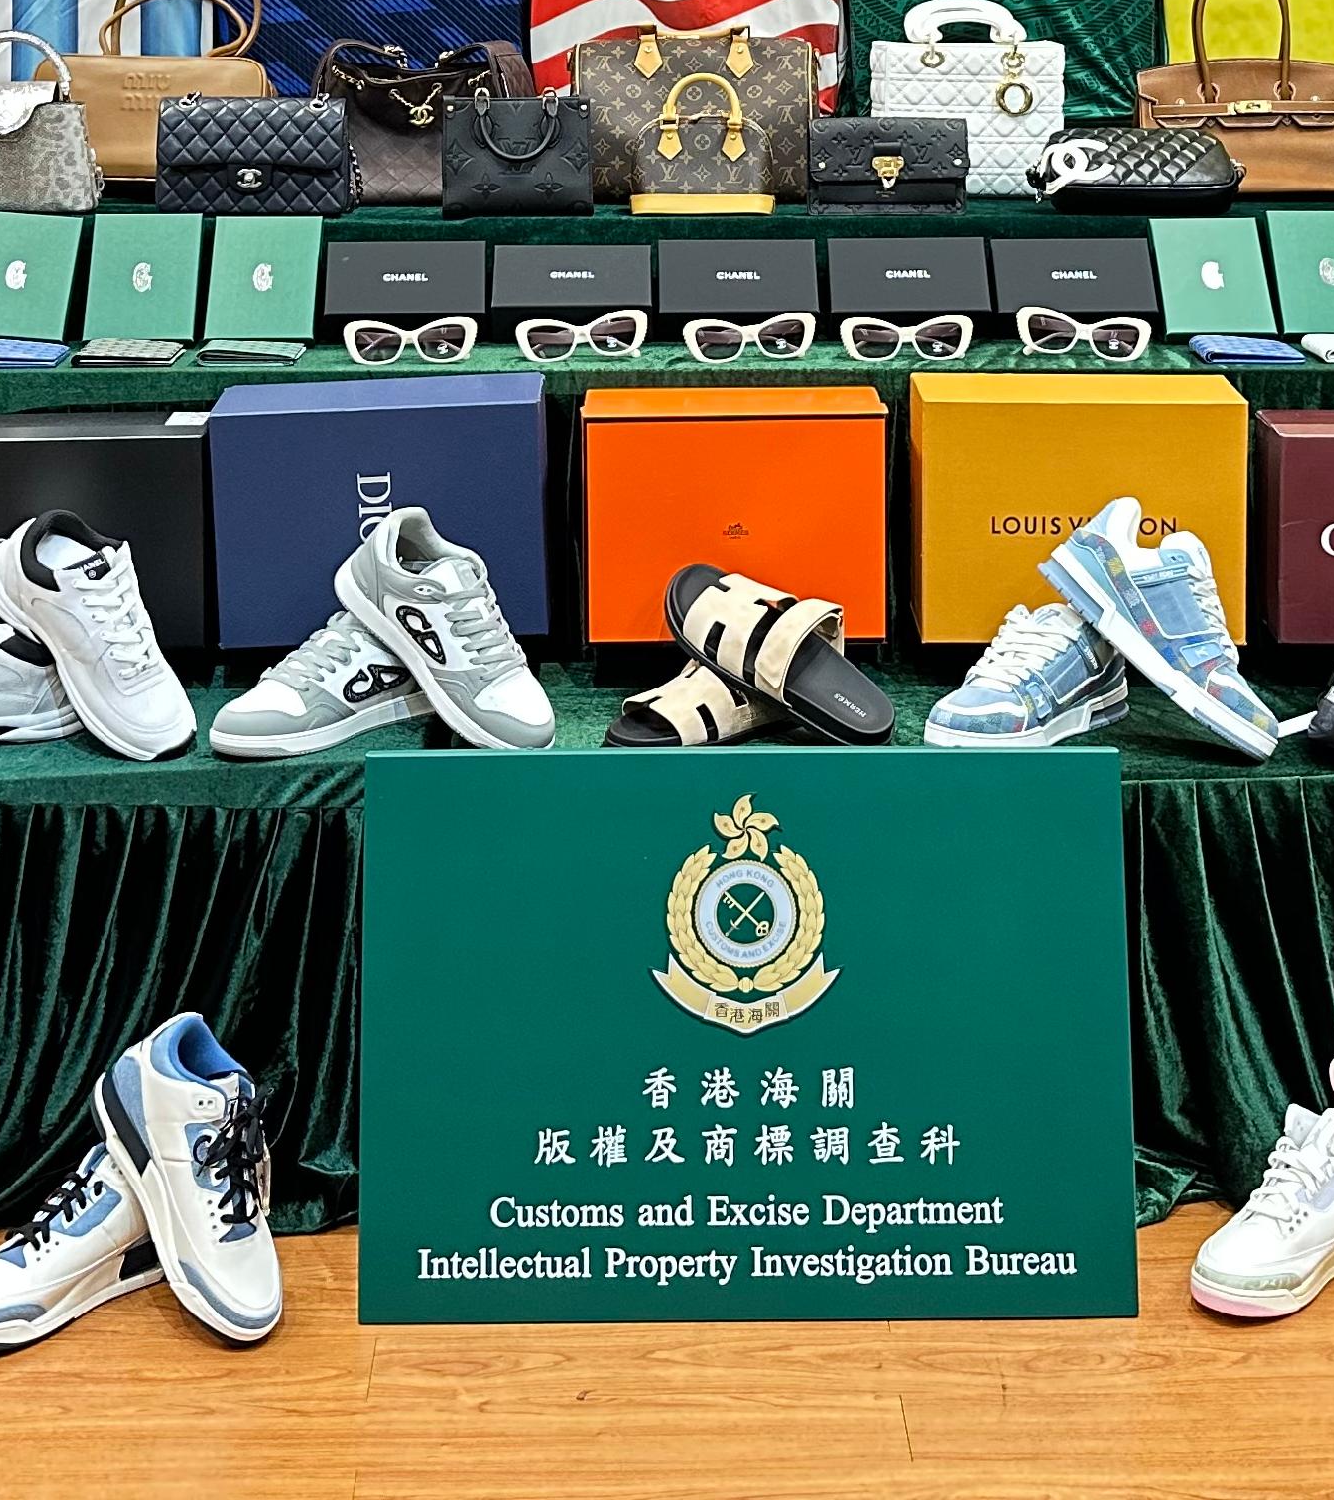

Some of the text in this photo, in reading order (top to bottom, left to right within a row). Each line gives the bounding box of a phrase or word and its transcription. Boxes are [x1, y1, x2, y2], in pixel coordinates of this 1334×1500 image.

[383, 273, 428, 282] CHANEL
[550, 270, 595, 279] CHANEL
[716, 271, 760, 280] CHANEL
[885, 269, 931, 279] CHANEL
[1051, 270, 1097, 280] CHANEL
[991, 516, 1061, 535] LOUIS
[716, 869, 775, 888] HONG KONG
[705, 920, 787, 959] CUSTOMS AND EXCISE
[714, 1002, 780, 1024] 香港海關
[642, 1066, 855, 1110] 香港海關
[533, 1122, 961, 1168] 版權及商標調查科
[490, 1194, 1004, 1234] Customs and Excise Department
[417, 1245, 1078, 1286] Intellectual Property Investigation Bureau
